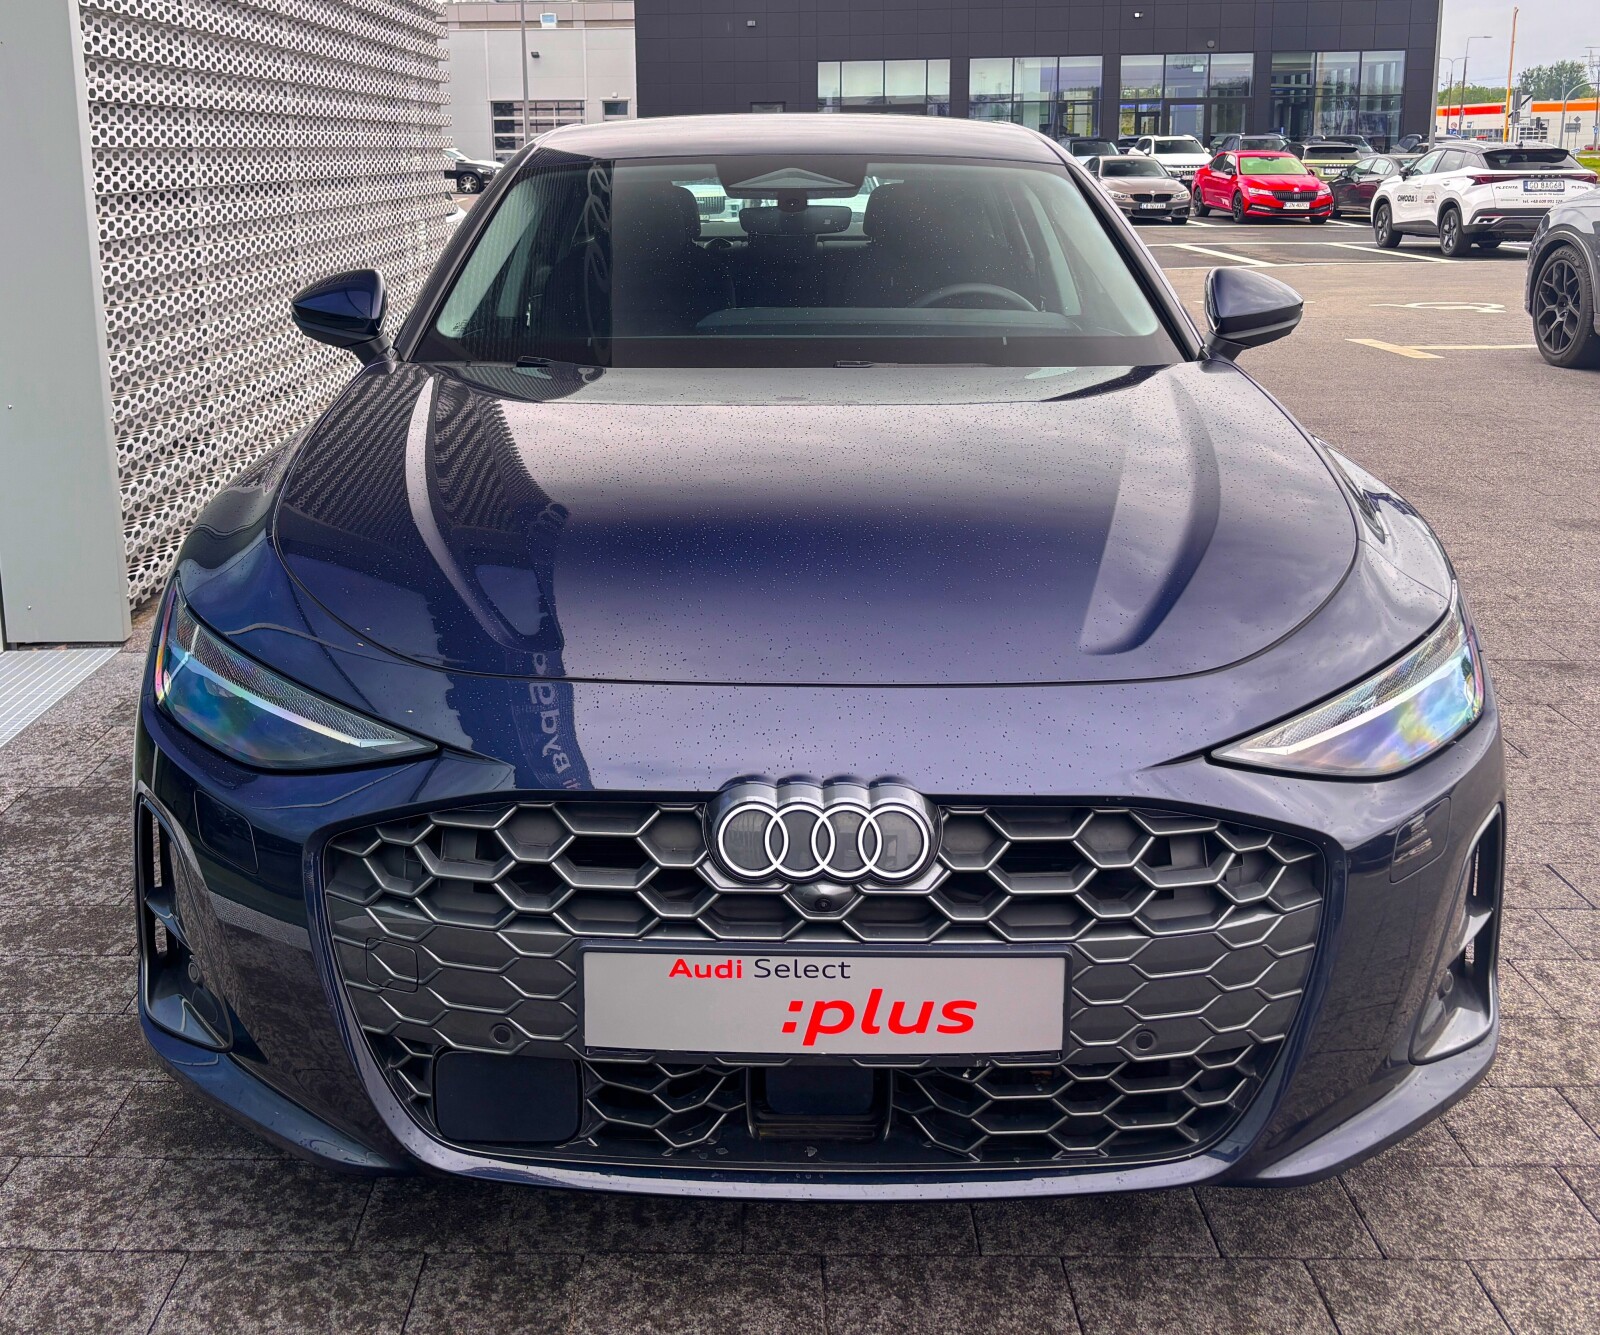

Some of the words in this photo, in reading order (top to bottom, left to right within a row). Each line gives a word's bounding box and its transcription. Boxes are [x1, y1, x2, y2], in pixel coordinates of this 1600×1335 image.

[668, 958, 742, 979] Audi
[753, 958, 852, 979] Select
[781, 988, 978, 1046] :plus
